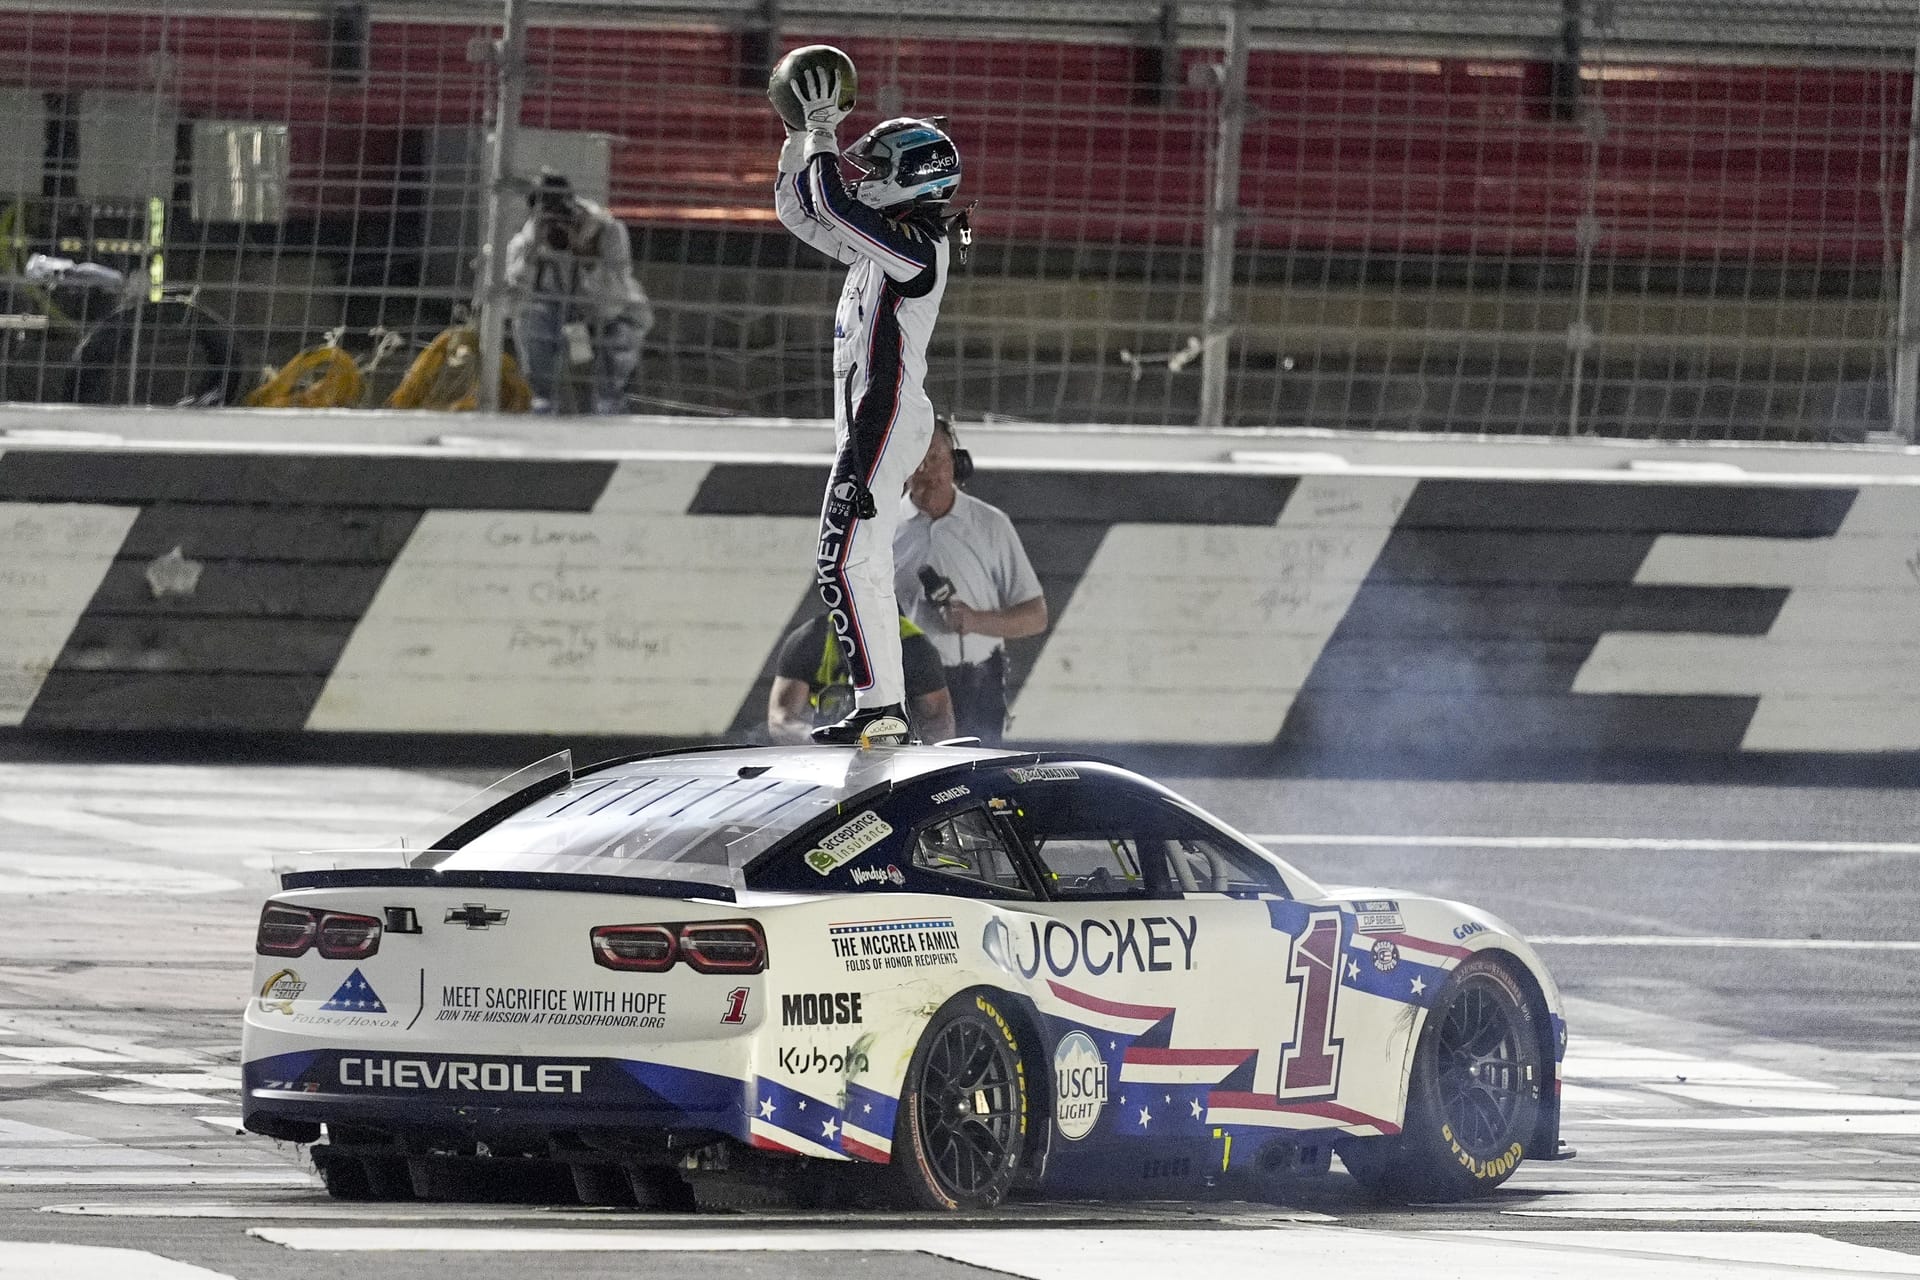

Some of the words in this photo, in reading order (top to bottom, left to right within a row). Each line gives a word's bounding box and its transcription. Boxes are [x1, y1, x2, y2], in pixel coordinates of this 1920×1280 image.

[931, 784, 971, 804] SIEMENS
[822, 813, 878, 850] acceptance
[834, 823, 889, 859] insurance
[850, 864, 888, 885] Wendy's
[832, 937, 858, 957] THE
[860, 933, 917, 955] MCCREA
[918, 931, 960, 951] FAMILY
[1016, 915, 1197, 980] JOCKEY
[846, 959, 871, 972] FOLDS
[873, 957, 882, 970] OF
[885, 955, 914, 969] HONOR
[915, 952, 958, 967] RECIPIENTS
[273, 981, 307, 991] QUAKER
[275, 990, 300, 1000] STATE
[442, 986, 480, 1008] MEET
[486, 987, 567, 1011] SACRIFICE
[573, 990, 615, 1012] WITH
[621, 992, 667, 1014] HOPE
[435, 1009, 459, 1021] JOIN
[461, 1010, 482, 1022] THE
[482, 1011, 530, 1024] MISSION
[532, 1013, 546, 1025] AT
[547, 1013, 666, 1029] FOLDSOFHONOR.ORG
[720, 986, 750, 1025] 1
[782, 992, 863, 1026] MOOSE
[1277, 906, 1344, 1104] 1
[779, 1045, 869, 1075] Kubota
[339, 1057, 591, 1094] CHEVROLET
[1059, 1065, 1107, 1100] USCH
[1059, 1103, 1094, 1121] LIGHT
